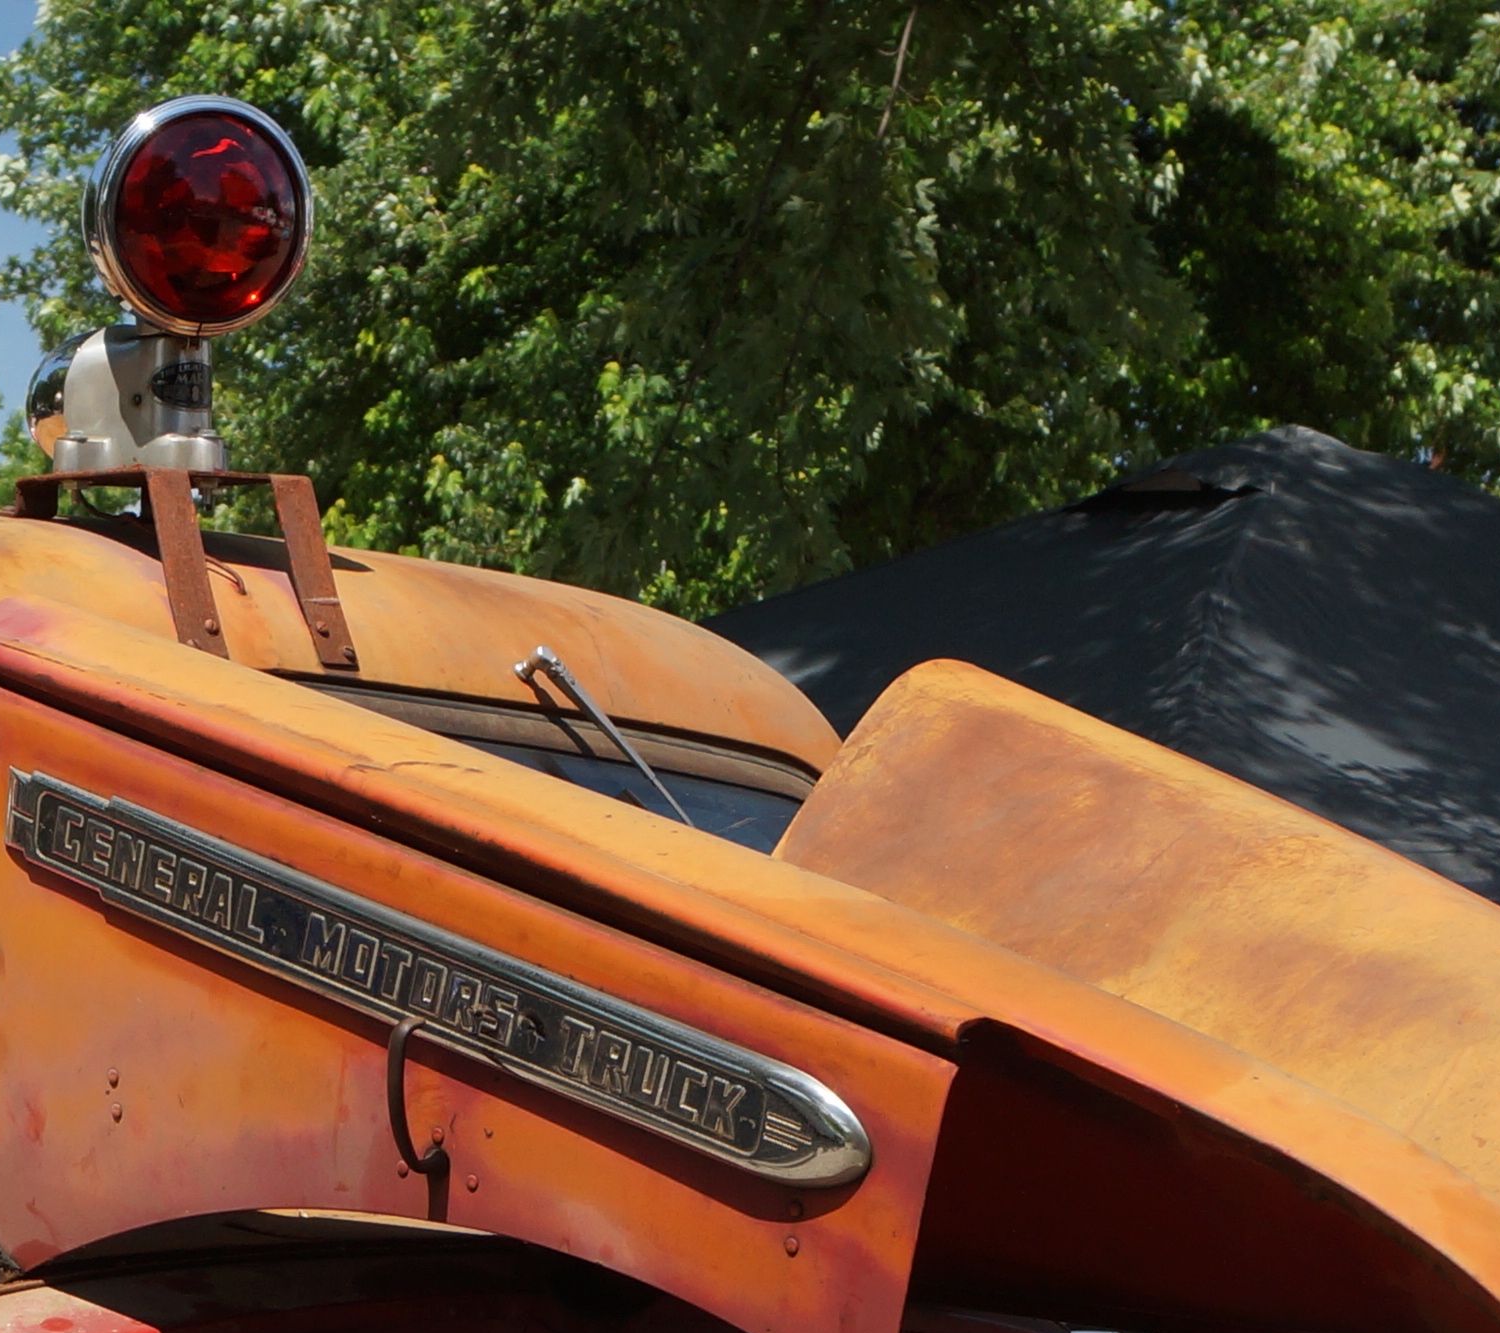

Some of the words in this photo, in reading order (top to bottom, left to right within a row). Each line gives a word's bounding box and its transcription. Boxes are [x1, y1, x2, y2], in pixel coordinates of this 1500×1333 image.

[52, 805, 264, 945] GENERAL
[301, 912, 518, 1047] MOTORS
[559, 1015, 746, 1141] TRUCK
